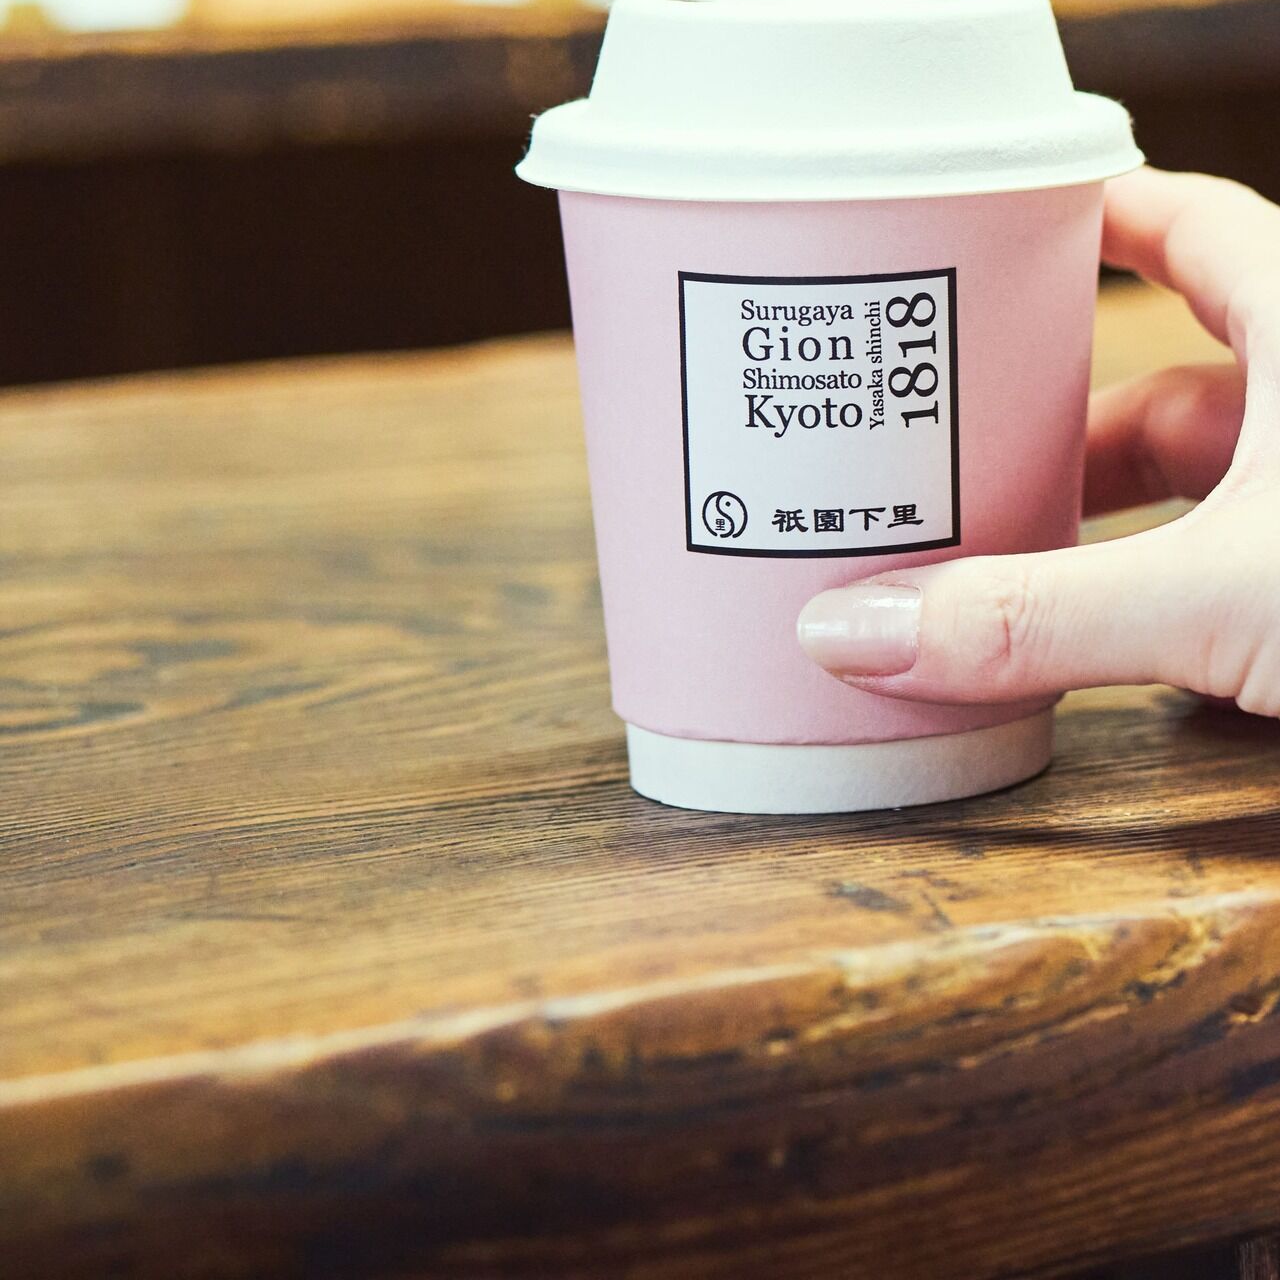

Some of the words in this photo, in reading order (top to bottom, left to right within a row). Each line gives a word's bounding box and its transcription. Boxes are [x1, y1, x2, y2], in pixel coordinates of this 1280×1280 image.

[741, 299, 854, 326] Surugaya
[864, 300, 882, 364] shinchi
[742, 326, 854, 362] Gion
[885, 292, 938, 428] 1818
[742, 368, 862, 390] Shimosato
[867, 368, 885, 430] Yasaka
[744, 394, 863, 438] Kyoto
